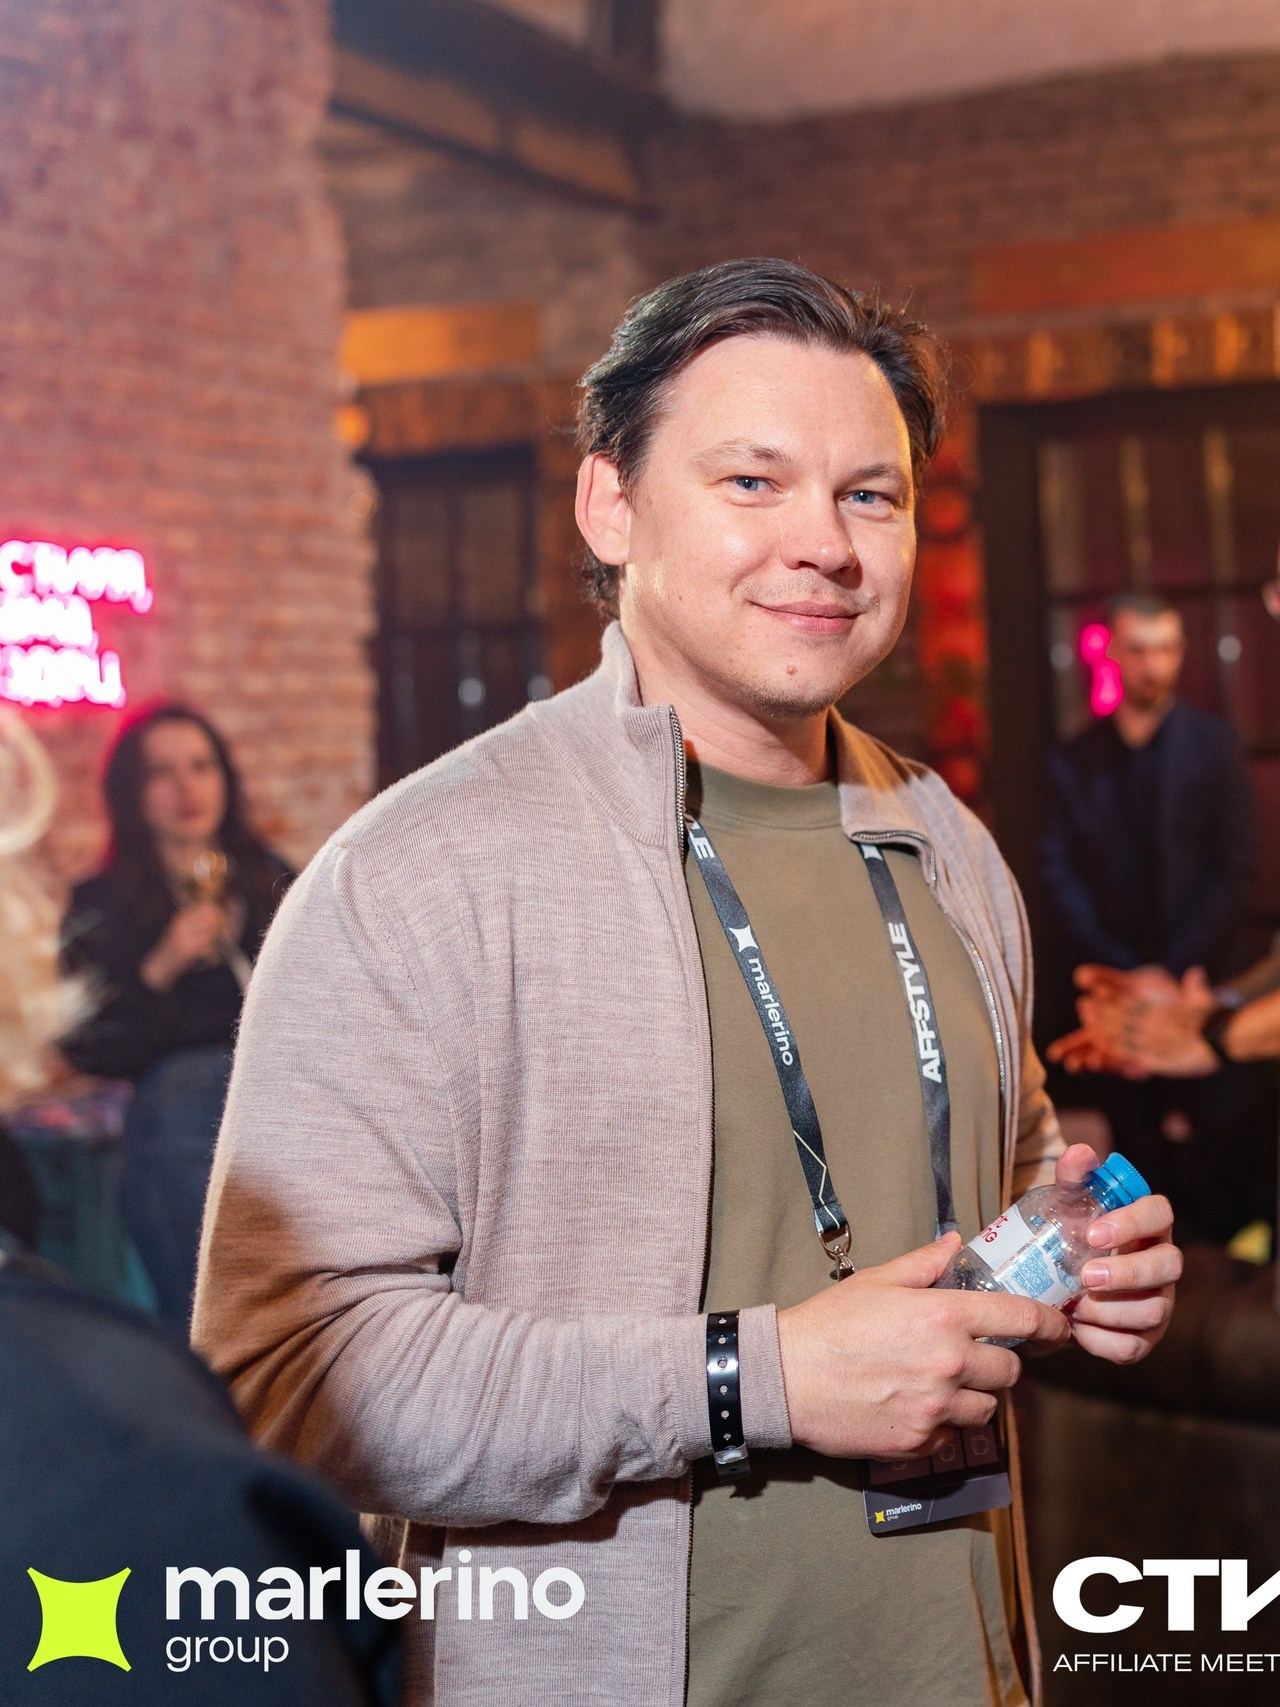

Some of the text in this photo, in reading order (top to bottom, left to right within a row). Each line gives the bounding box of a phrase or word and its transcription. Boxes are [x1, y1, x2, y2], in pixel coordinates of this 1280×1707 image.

[748, 958, 794, 1066] marlerino
[888, 922, 942, 1083] AFFSTYLE
[886, 1502, 923, 1516] marlerino
